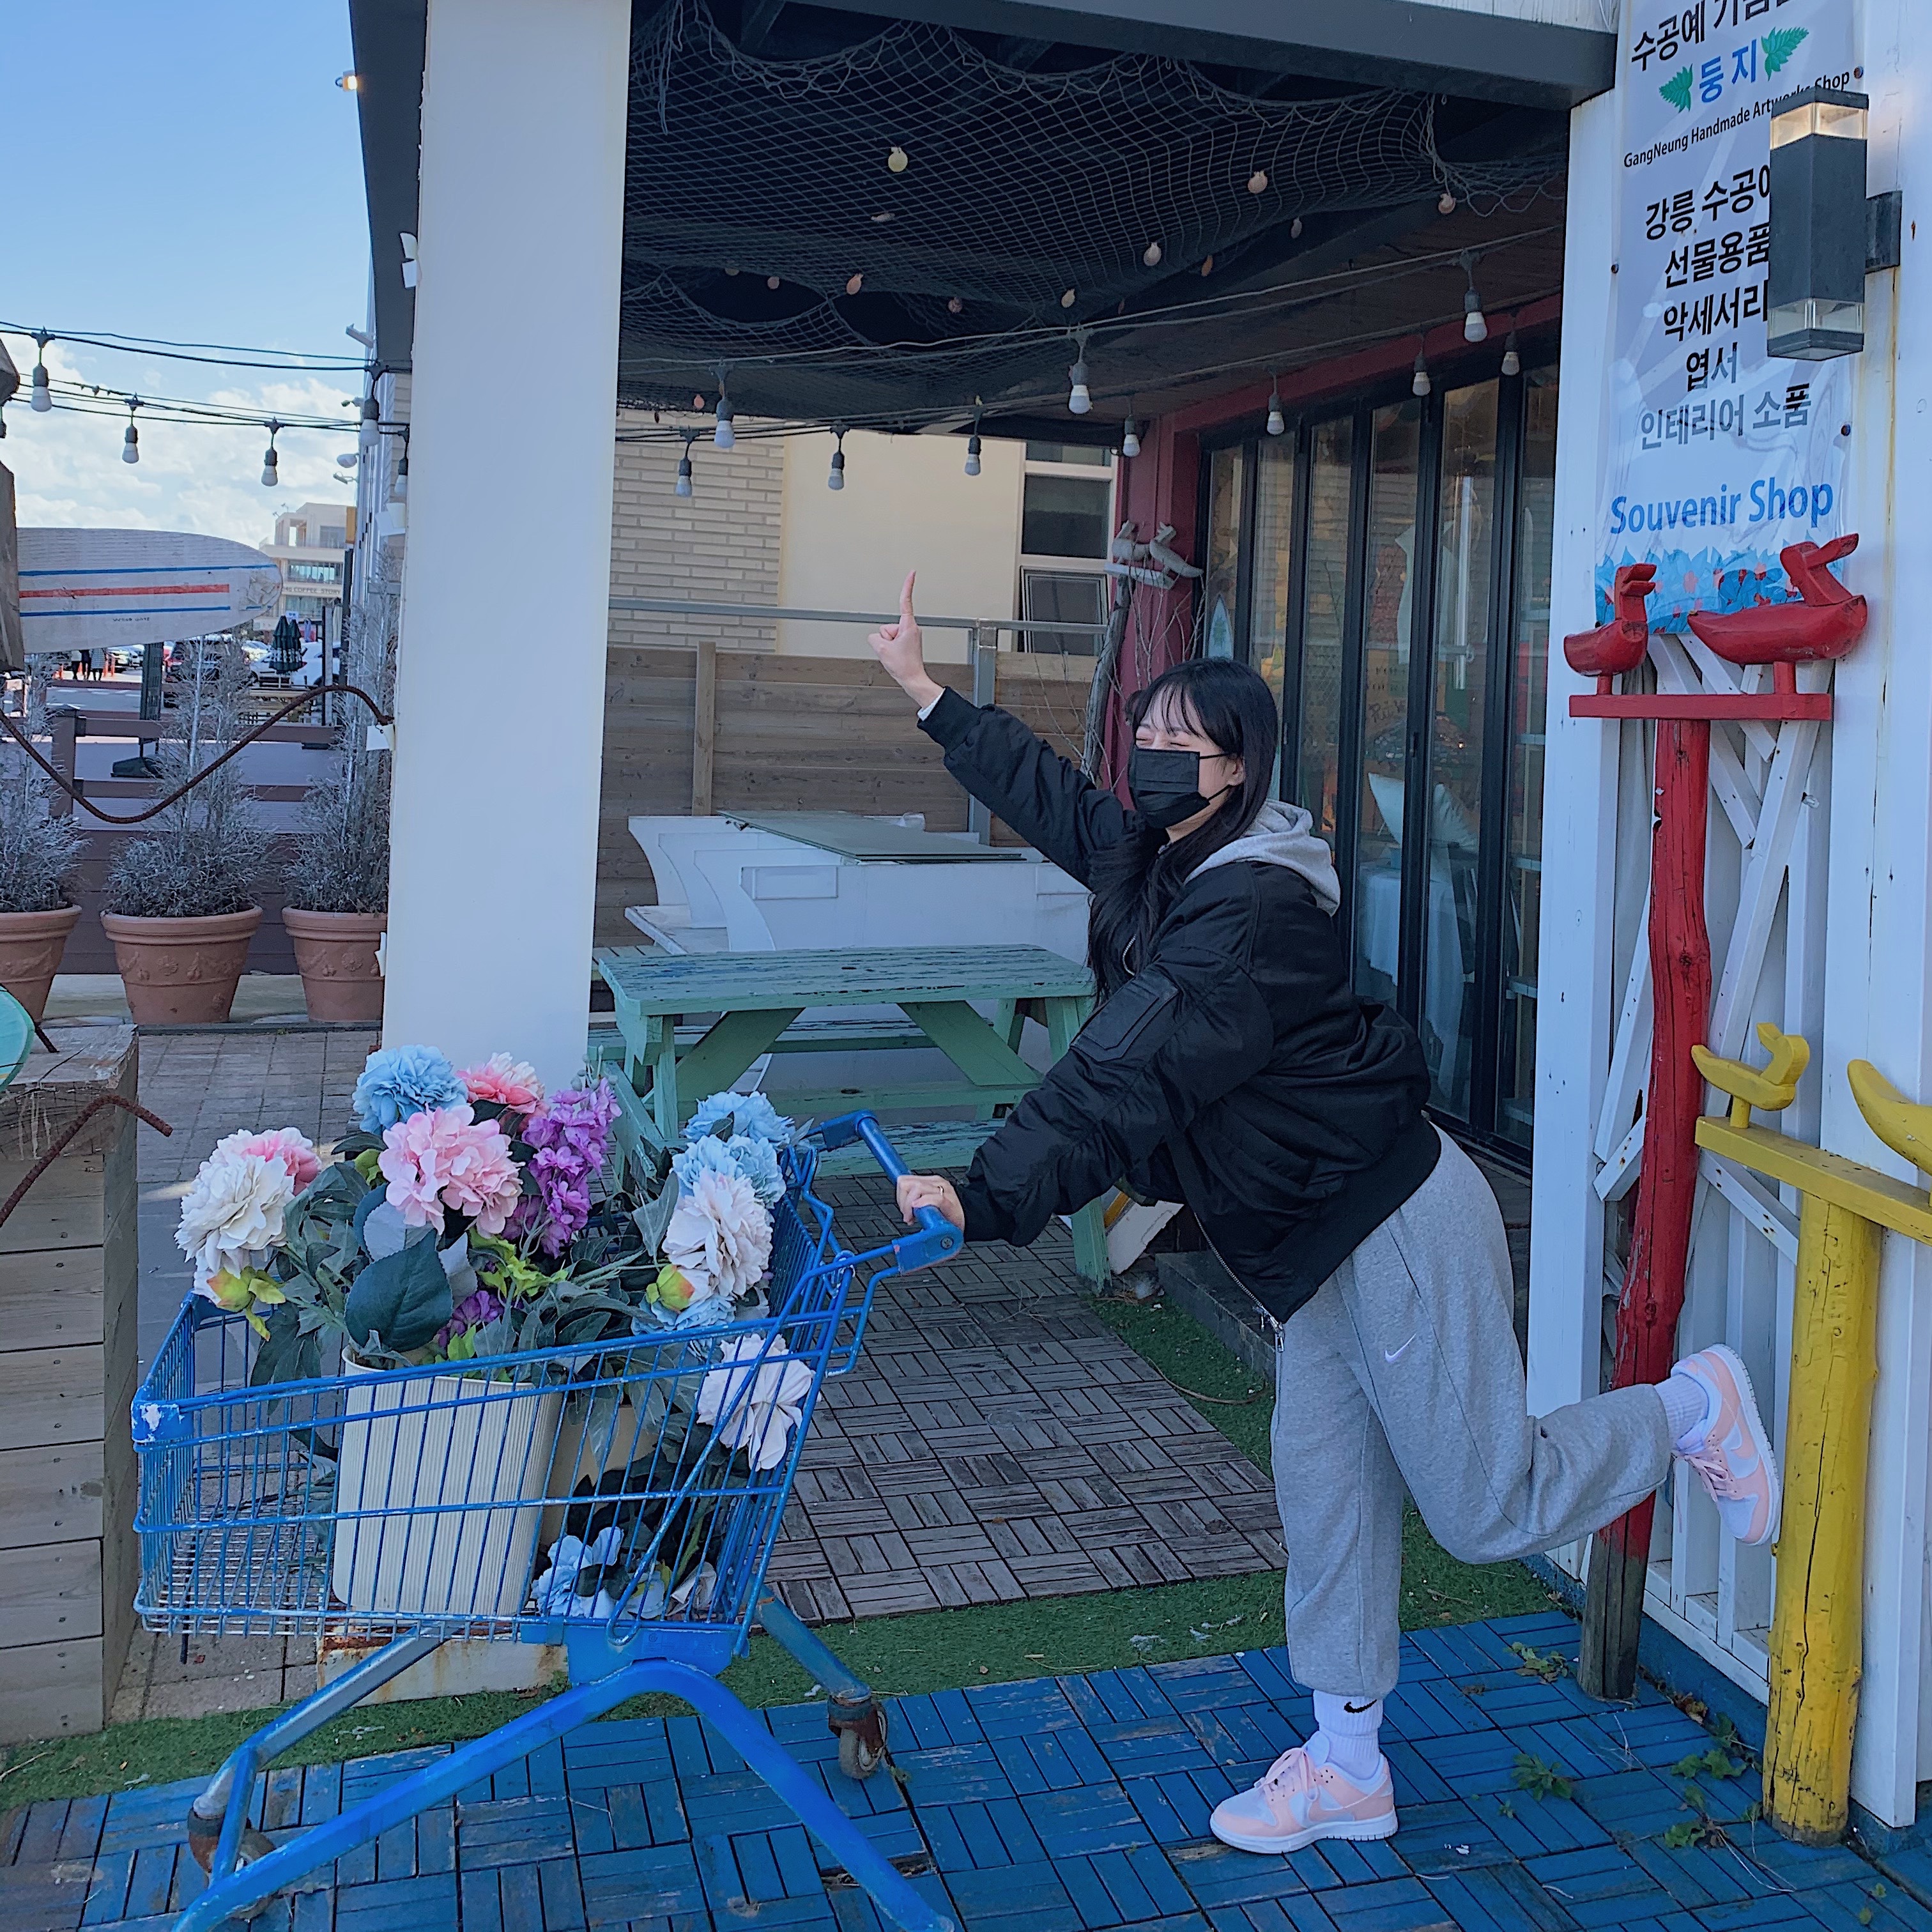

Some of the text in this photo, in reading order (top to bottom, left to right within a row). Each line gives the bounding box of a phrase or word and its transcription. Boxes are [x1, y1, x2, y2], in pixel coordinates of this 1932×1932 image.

[1631, 0, 1705, 72] 수공예
[1623, 134, 1689, 168] GangNeung
[1691, 107, 1751, 144] Handmade
[1646, 189, 1695, 240] 강릉
[1665, 221, 1770, 289] 선물용품
[1664, 279, 1768, 342] 악세서리
[1686, 342, 1738, 392] 엽서
[1641, 383, 1811, 450] 인테리어 소품
[1610, 477, 1834, 535] Souvenir Shop
